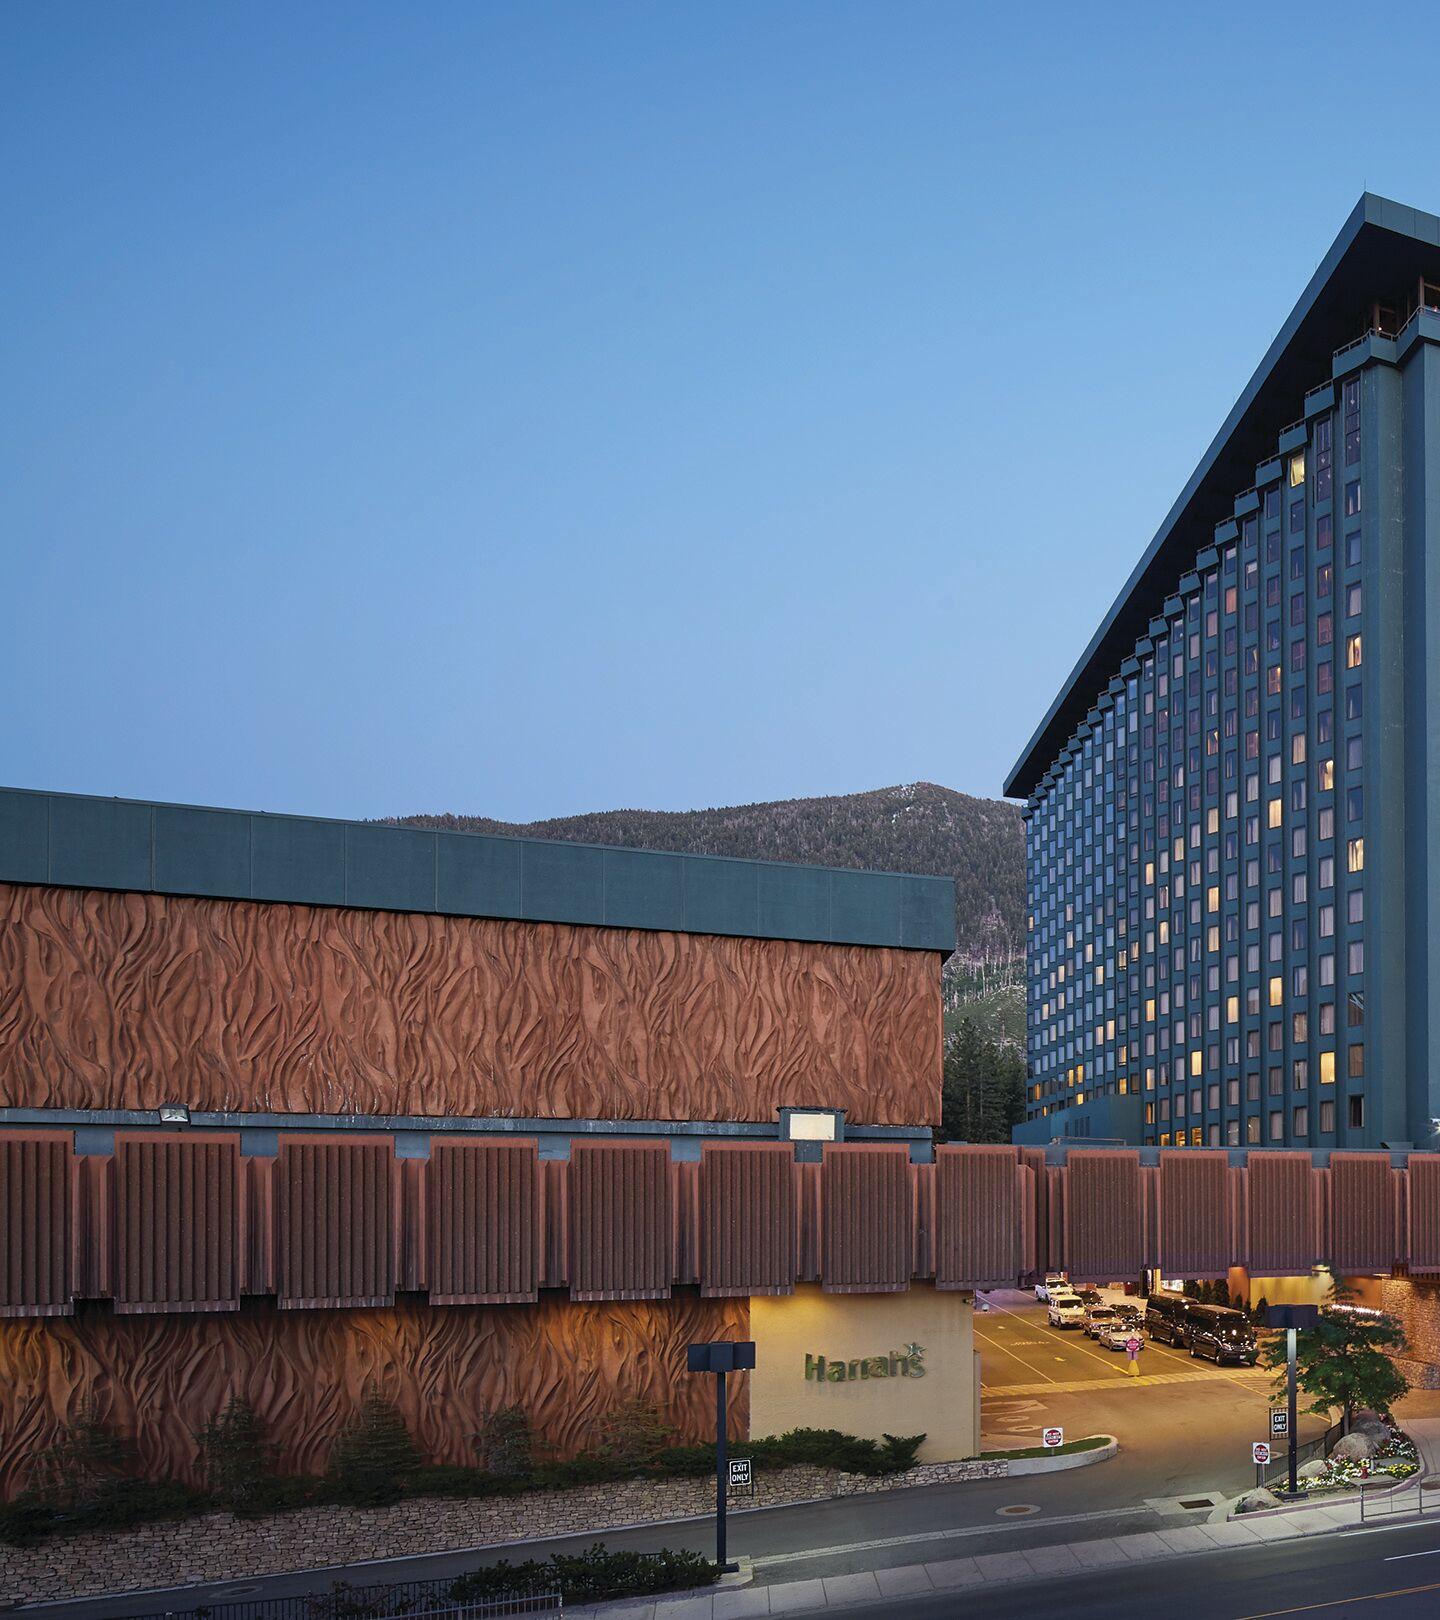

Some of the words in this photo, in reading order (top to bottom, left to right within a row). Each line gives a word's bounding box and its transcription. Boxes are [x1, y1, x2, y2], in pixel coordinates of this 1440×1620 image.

[804, 1342, 927, 1382] Harrah's
[1274, 1415, 1286, 1423] EXIT
[732, 1463, 748, 1473] EXIT
[731, 1473, 749, 1482] ONLY
